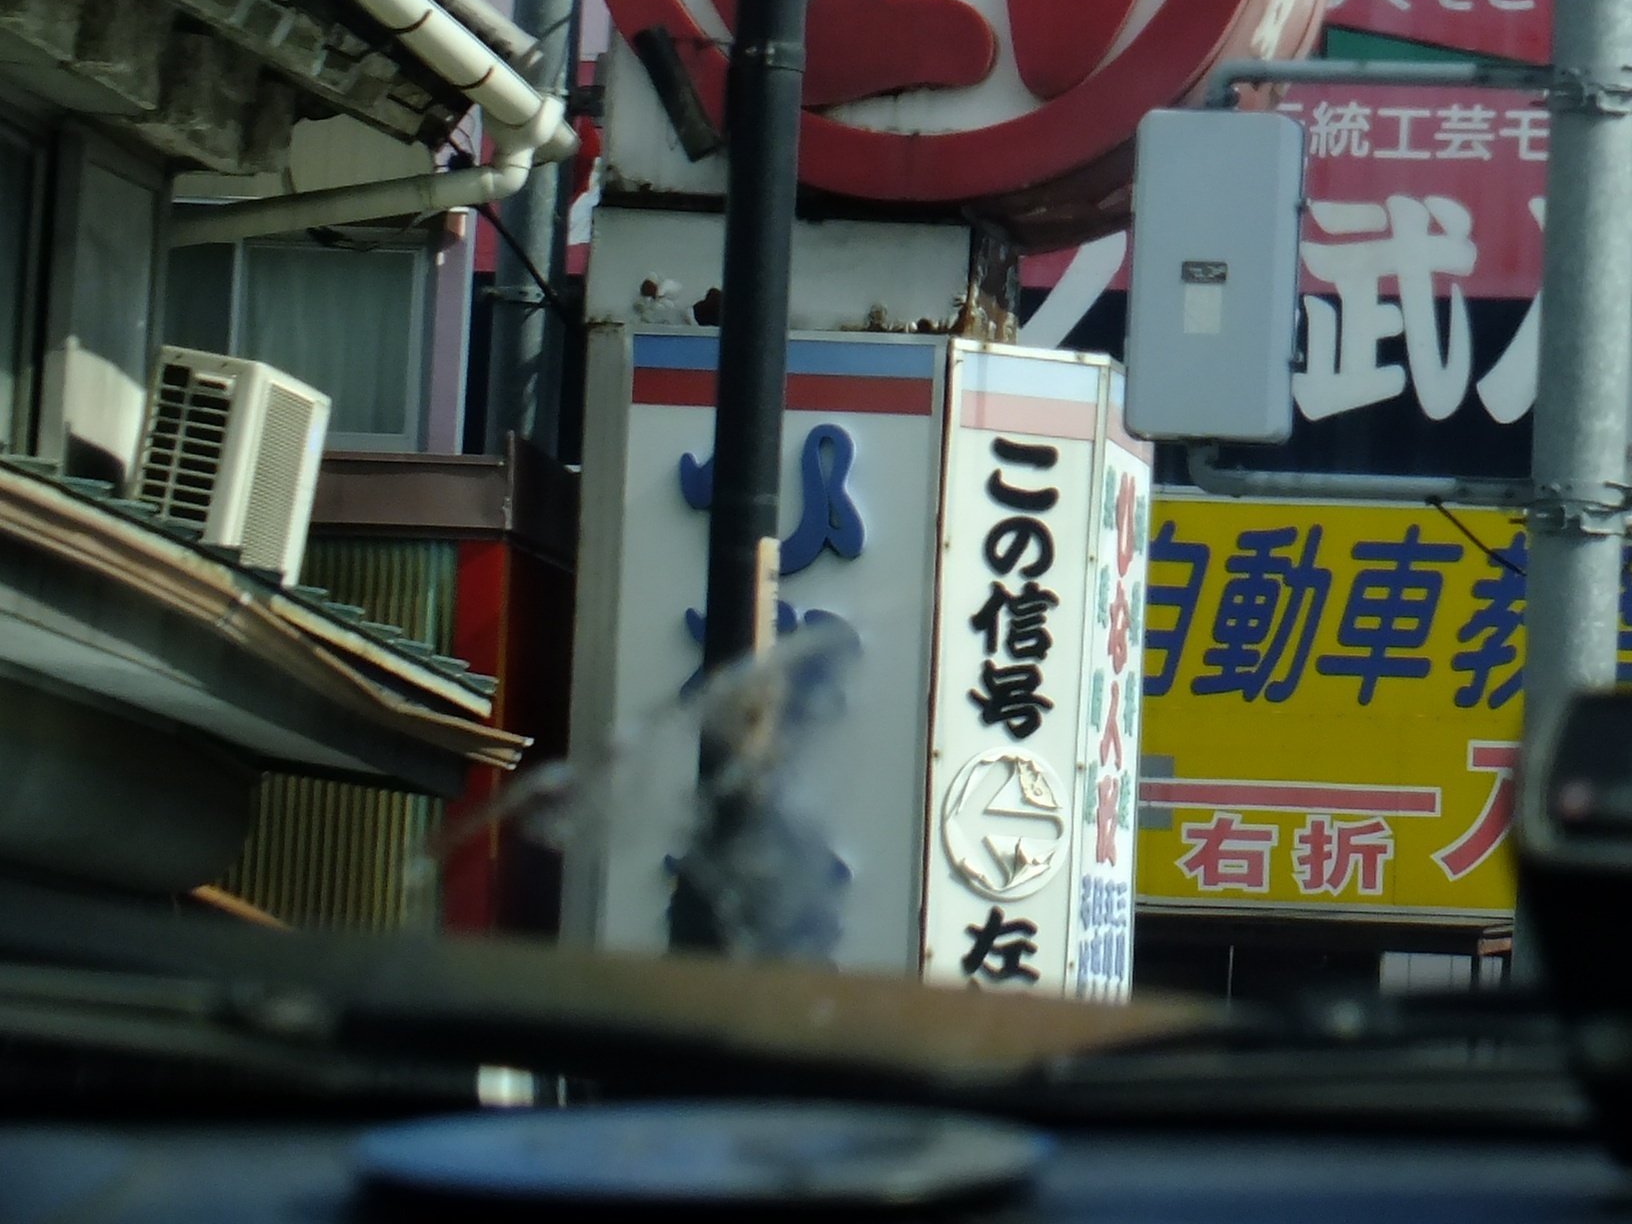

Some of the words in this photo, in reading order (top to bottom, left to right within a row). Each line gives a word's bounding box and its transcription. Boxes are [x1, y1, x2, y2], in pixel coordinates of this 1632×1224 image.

[967, 437, 1060, 740] この信号
[1174, 810, 1395, 897] 右折
